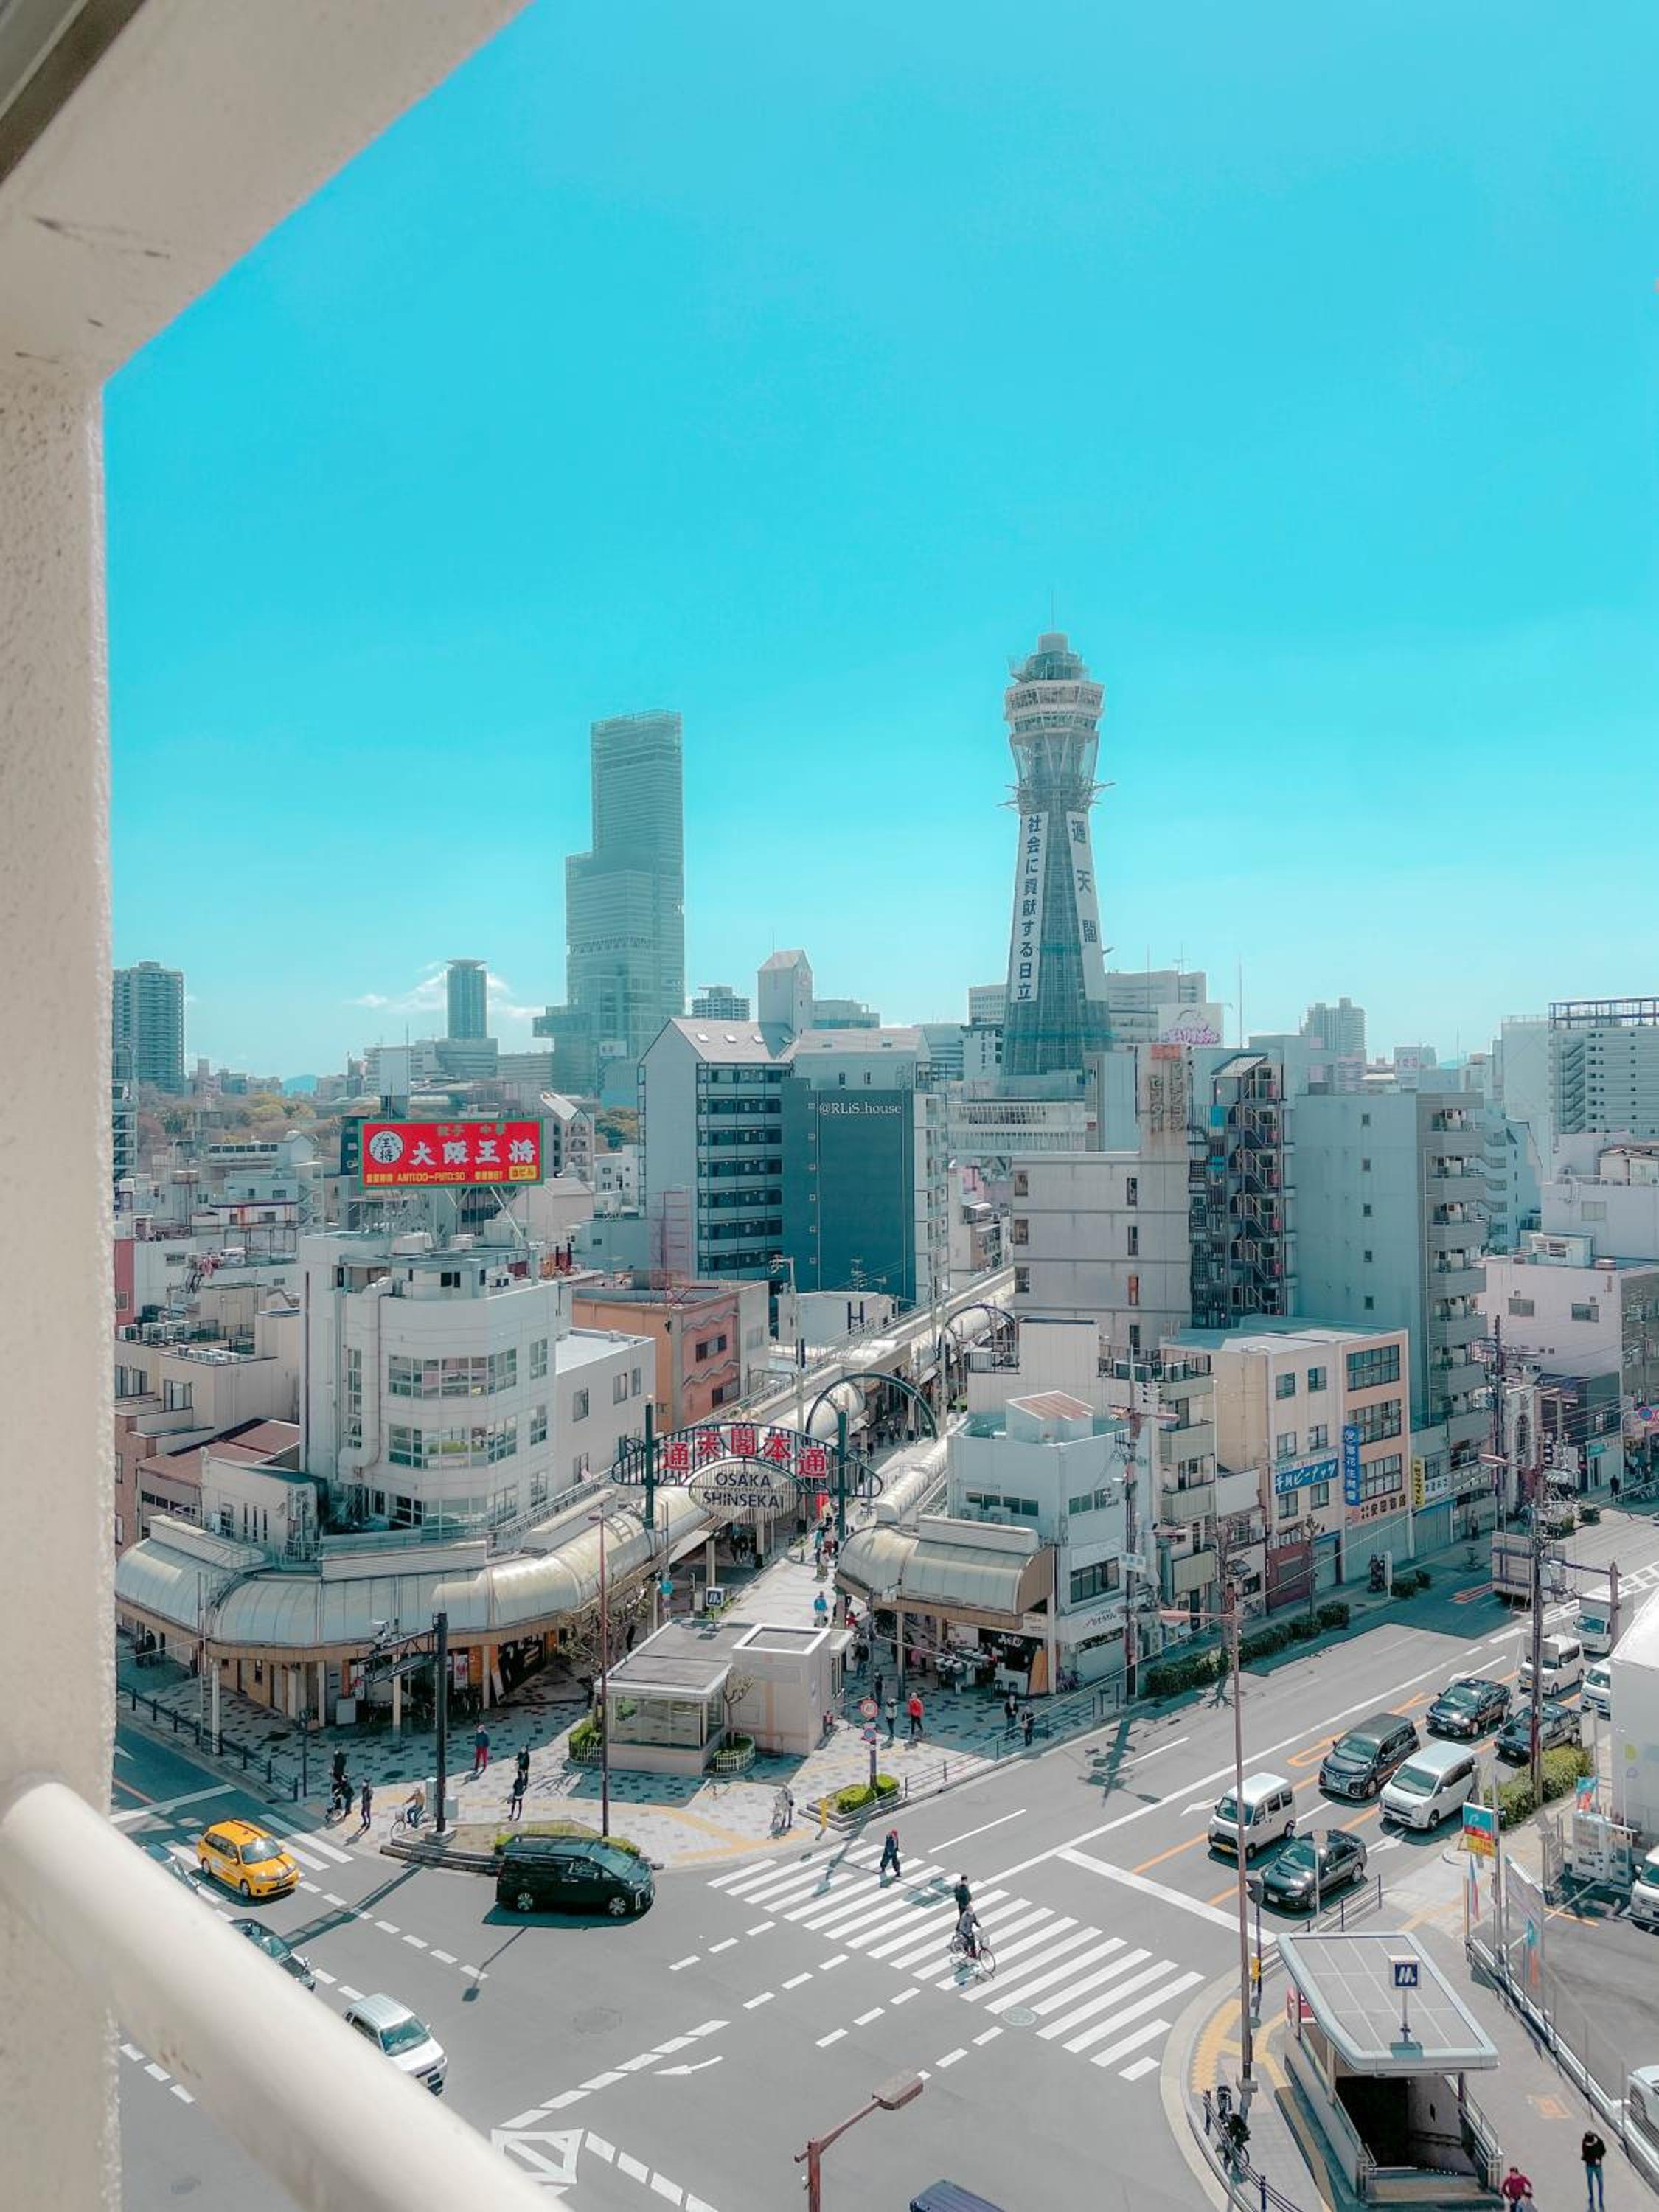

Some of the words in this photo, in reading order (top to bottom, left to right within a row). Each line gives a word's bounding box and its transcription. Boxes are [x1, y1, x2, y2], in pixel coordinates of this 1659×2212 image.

[1071, 819, 1098, 943] 通天閣
[1017, 815, 1042, 1001] 社会に貢献する日立
[409, 1138, 536, 1166] 大阪王将
[662, 1427, 827, 1478] 通天閣本通
[715, 1472, 771, 1488] OSAKA
[703, 1492, 785, 1509] SHINSEKAI
